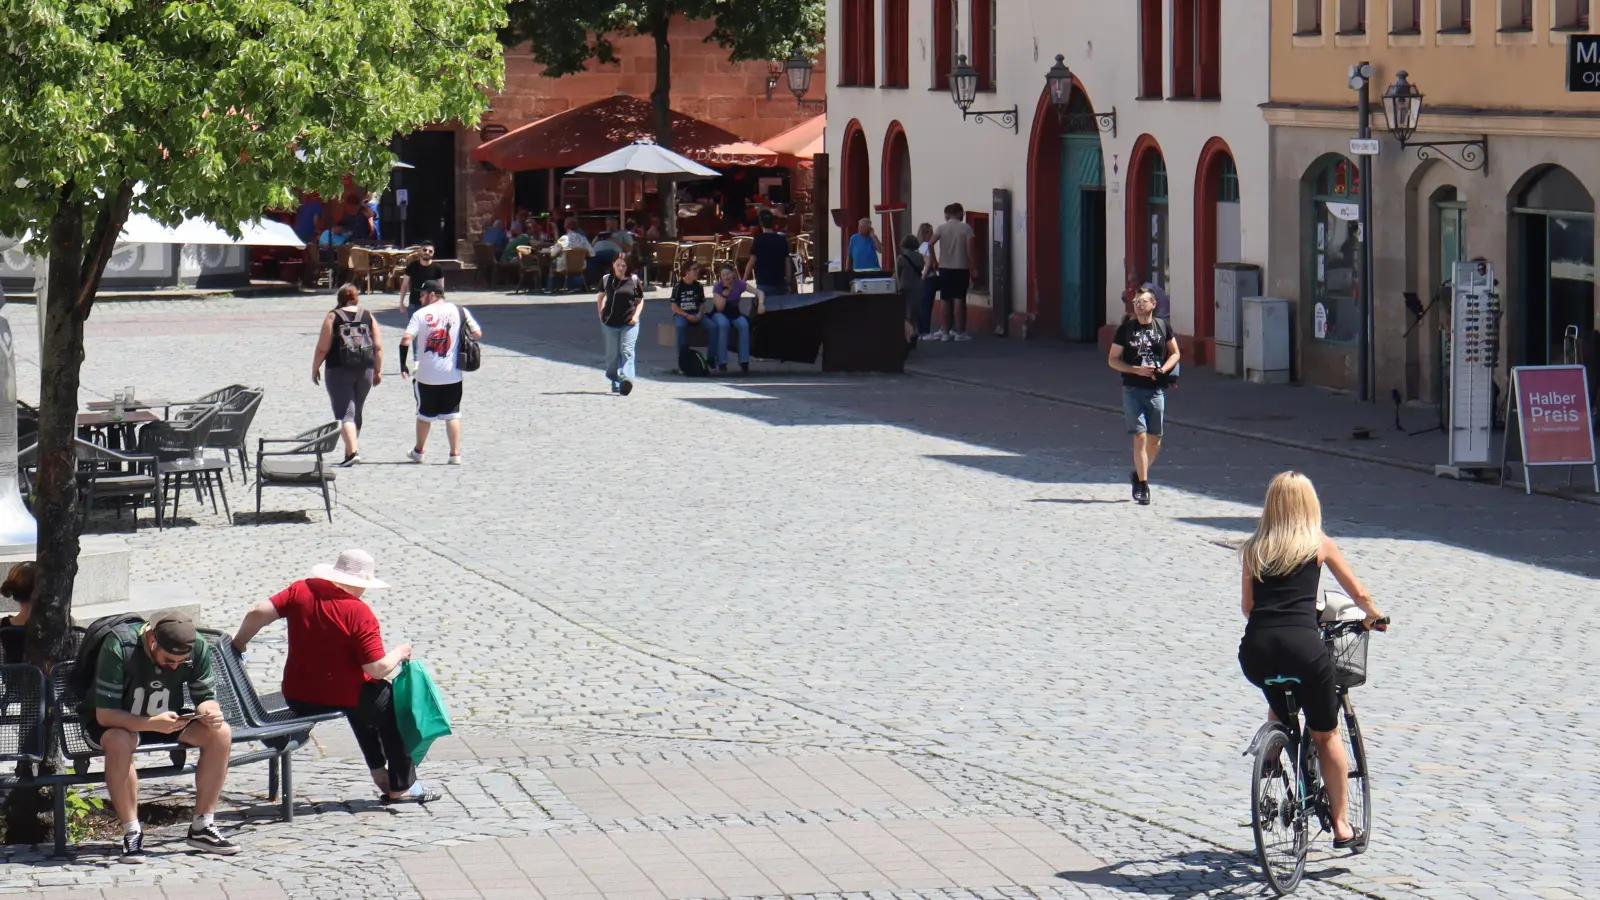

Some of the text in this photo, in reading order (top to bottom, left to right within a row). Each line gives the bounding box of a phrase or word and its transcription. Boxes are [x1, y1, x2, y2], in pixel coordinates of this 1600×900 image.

[1576, 41, 1600, 63] M
[1529, 391, 1576, 405] Halber
[1531, 405, 1579, 423] Preis
[150, 680, 163, 689] G
